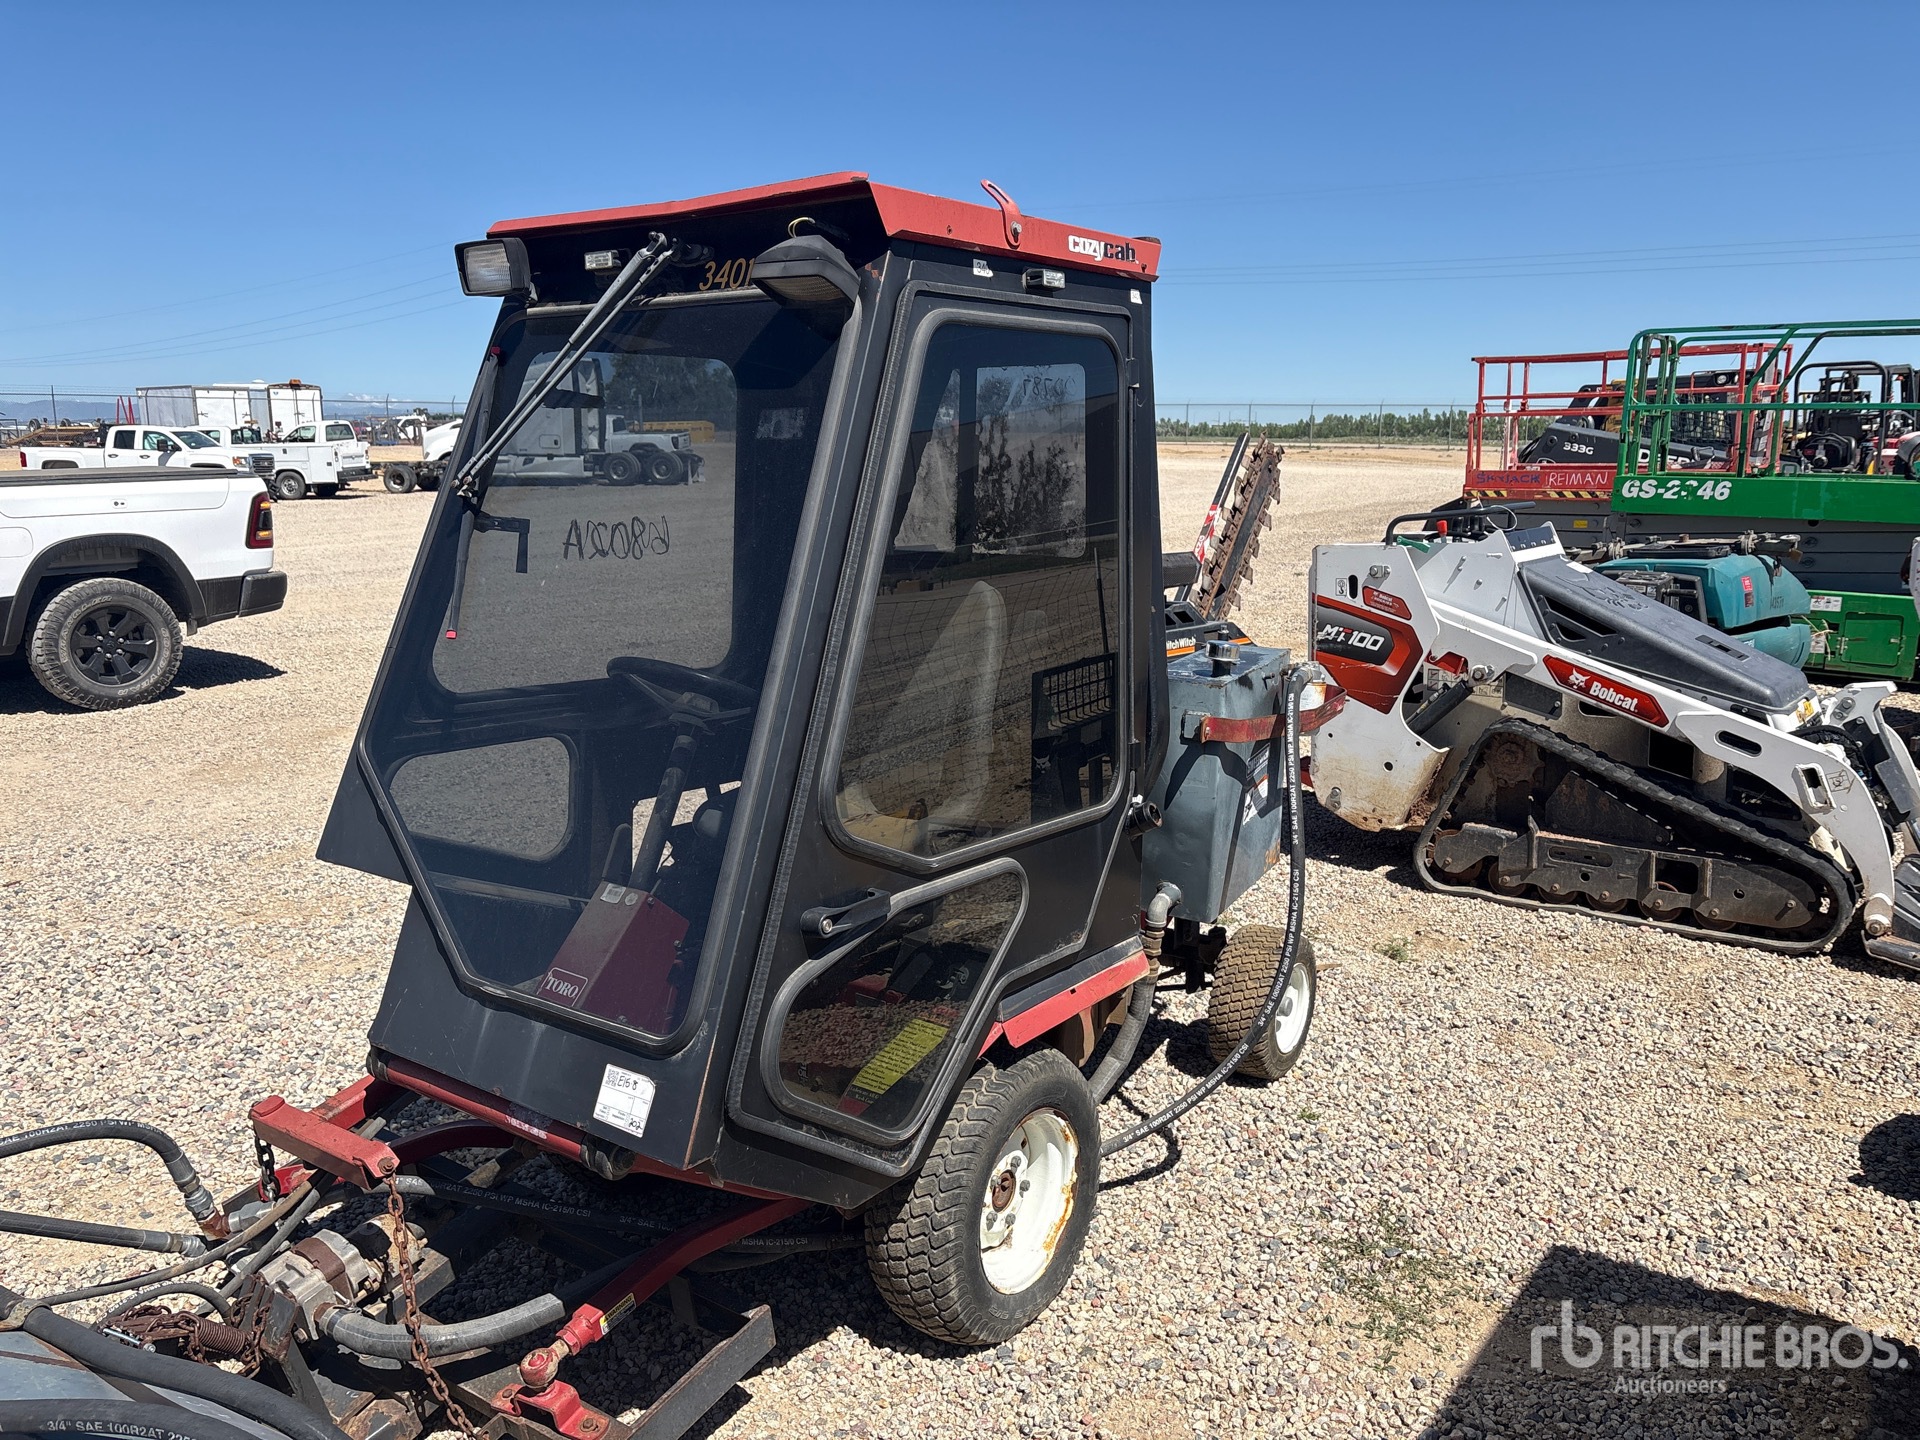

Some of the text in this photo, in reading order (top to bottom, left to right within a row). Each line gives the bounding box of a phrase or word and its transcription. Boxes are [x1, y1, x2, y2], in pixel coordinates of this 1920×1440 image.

[1563, 441, 1594, 455] 333G
[1589, 681, 1638, 712] Bobcat
[1288, 767, 1296, 782] 2250
[1289, 911, 1298, 932] MSHA
[1285, 944, 1293, 957] PSI
[1281, 957, 1290, 973] 2250
[545, 975, 579, 998] TORO
[1264, 1001, 1275, 1015] SAE
[1135, 1125, 1150, 1137] SAE
[1173, 1102, 1188, 1115] 2250
[1187, 1095, 1198, 1105] PSI
[1196, 1086, 1207, 1098] WP
[1205, 1072, 1223, 1090] MSHA
[1239, 1043, 1249, 1055] CSI
[515, 1197, 540, 1209] MSHA
[576, 1208, 591, 1218] CSI
[796, 1237, 808, 1245] CSI
[46, 1420, 72, 1431] 3/4"
[75, 1421, 103, 1432] SAE
[107, 1423, 165, 1439] 100R2AT
